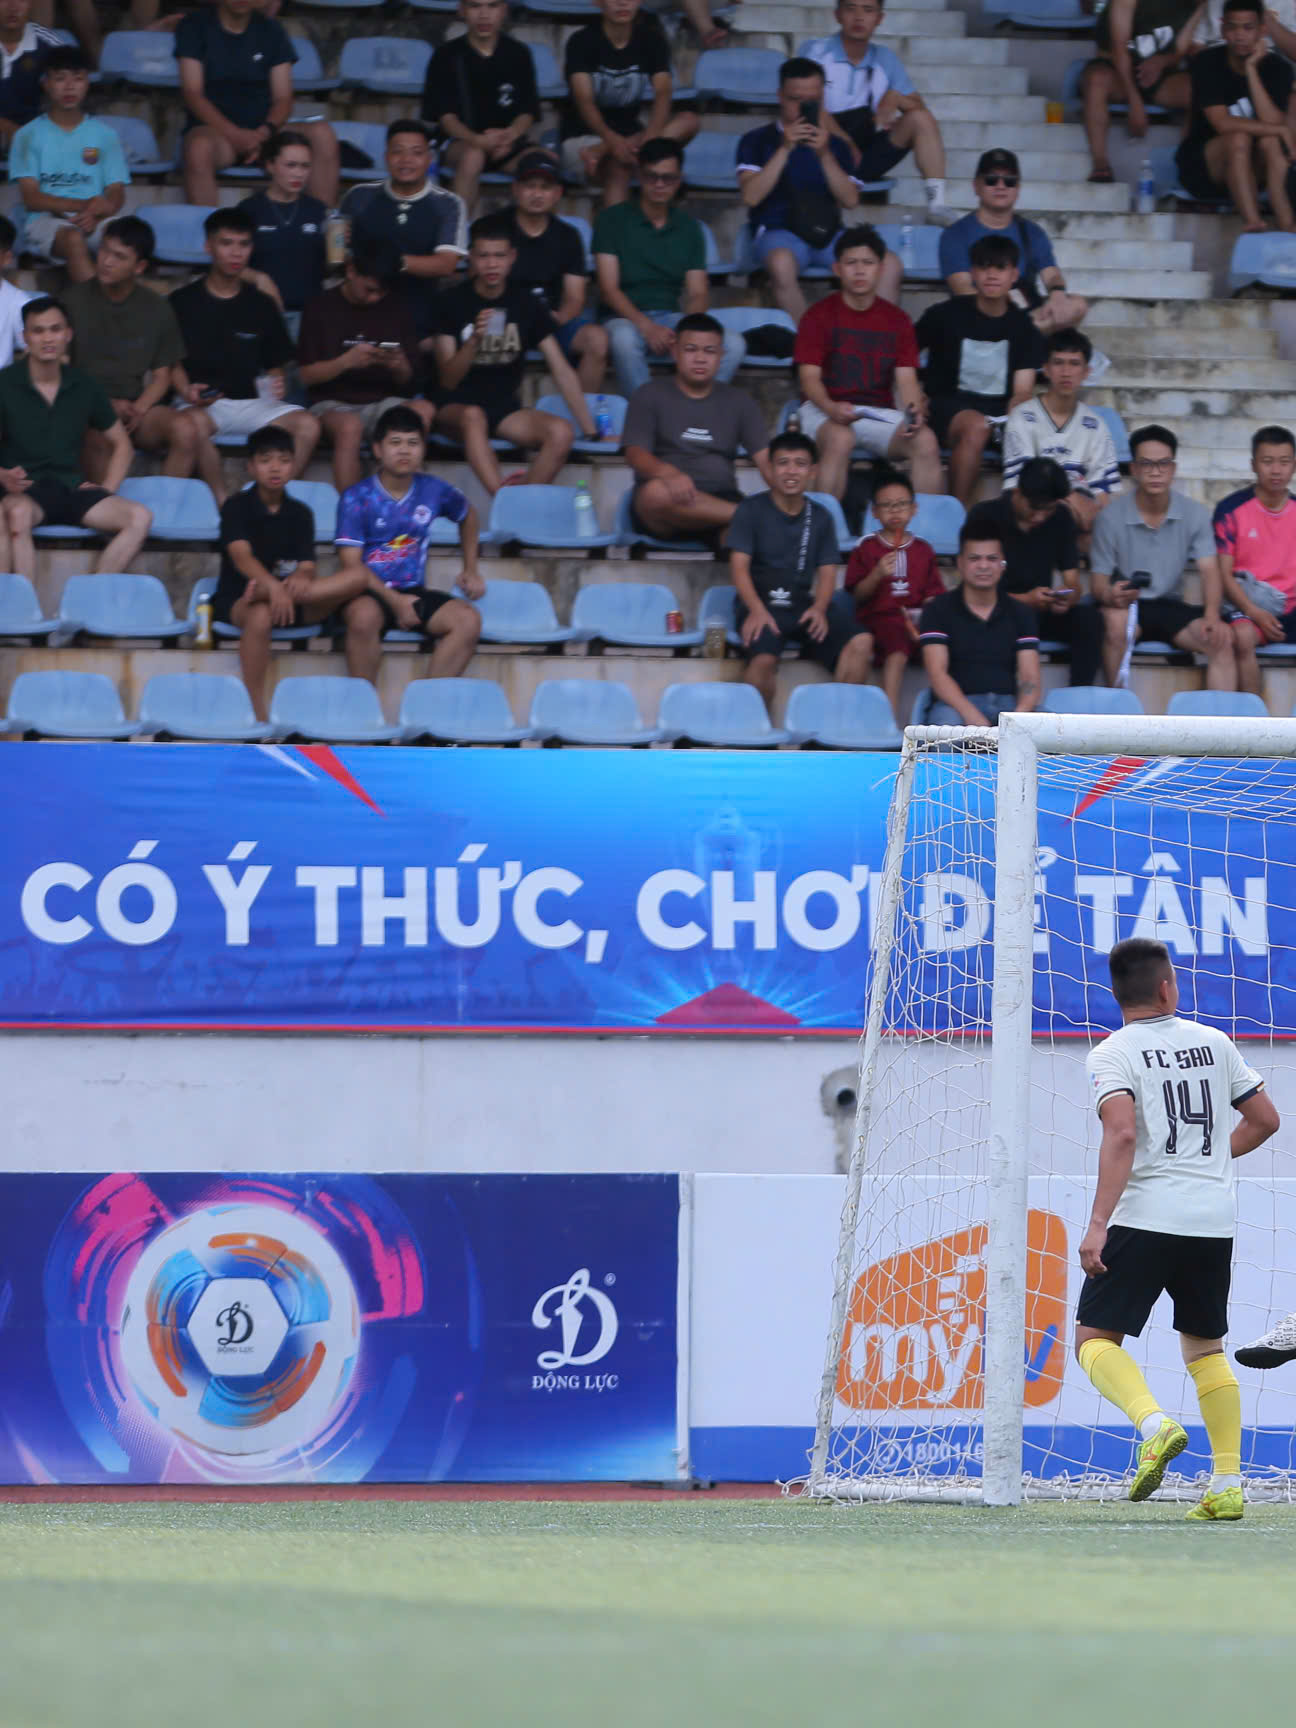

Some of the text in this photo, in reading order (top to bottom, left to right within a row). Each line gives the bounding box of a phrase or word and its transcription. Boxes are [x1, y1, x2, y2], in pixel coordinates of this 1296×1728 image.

[21, 839, 178, 946] CÓ
[201, 840, 273, 946] Ý
[295, 843, 610, 964] THỨC,
[1074, 852, 1268, 956] TÂN
[1141, 1045, 1215, 1070] FC SAO
[1162, 1079, 1214, 1157] 14
[532, 1371, 619, 1393] ĐỘNG LỰC
[850, 1311, 1058, 1404] myv
